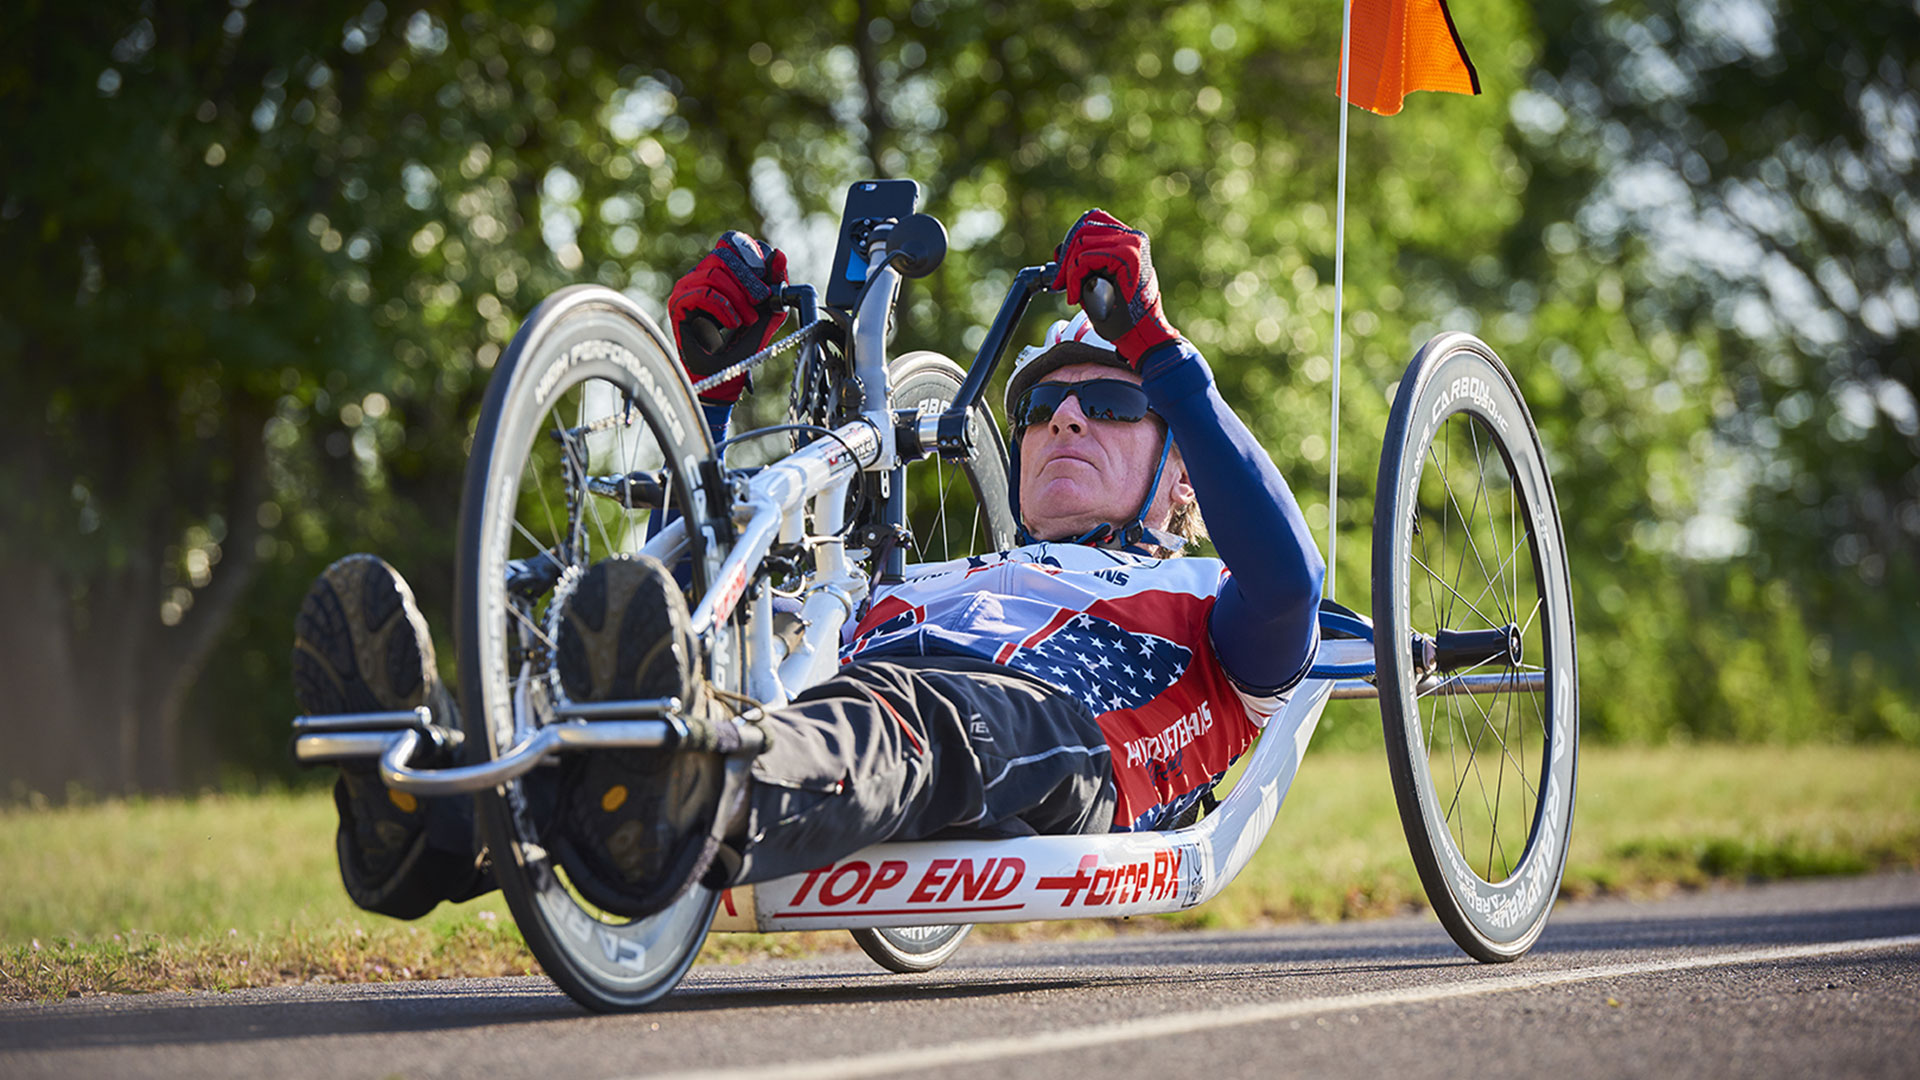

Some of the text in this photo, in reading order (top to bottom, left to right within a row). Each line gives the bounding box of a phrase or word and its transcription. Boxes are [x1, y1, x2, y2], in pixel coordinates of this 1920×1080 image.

[570, 339, 686, 447] PERFORMANCE
[1432, 376, 1490, 425] CARBON
[788, 860, 908, 907] TOP
[906, 857, 1026, 904] END
[1148, 848, 1183, 902] RX
